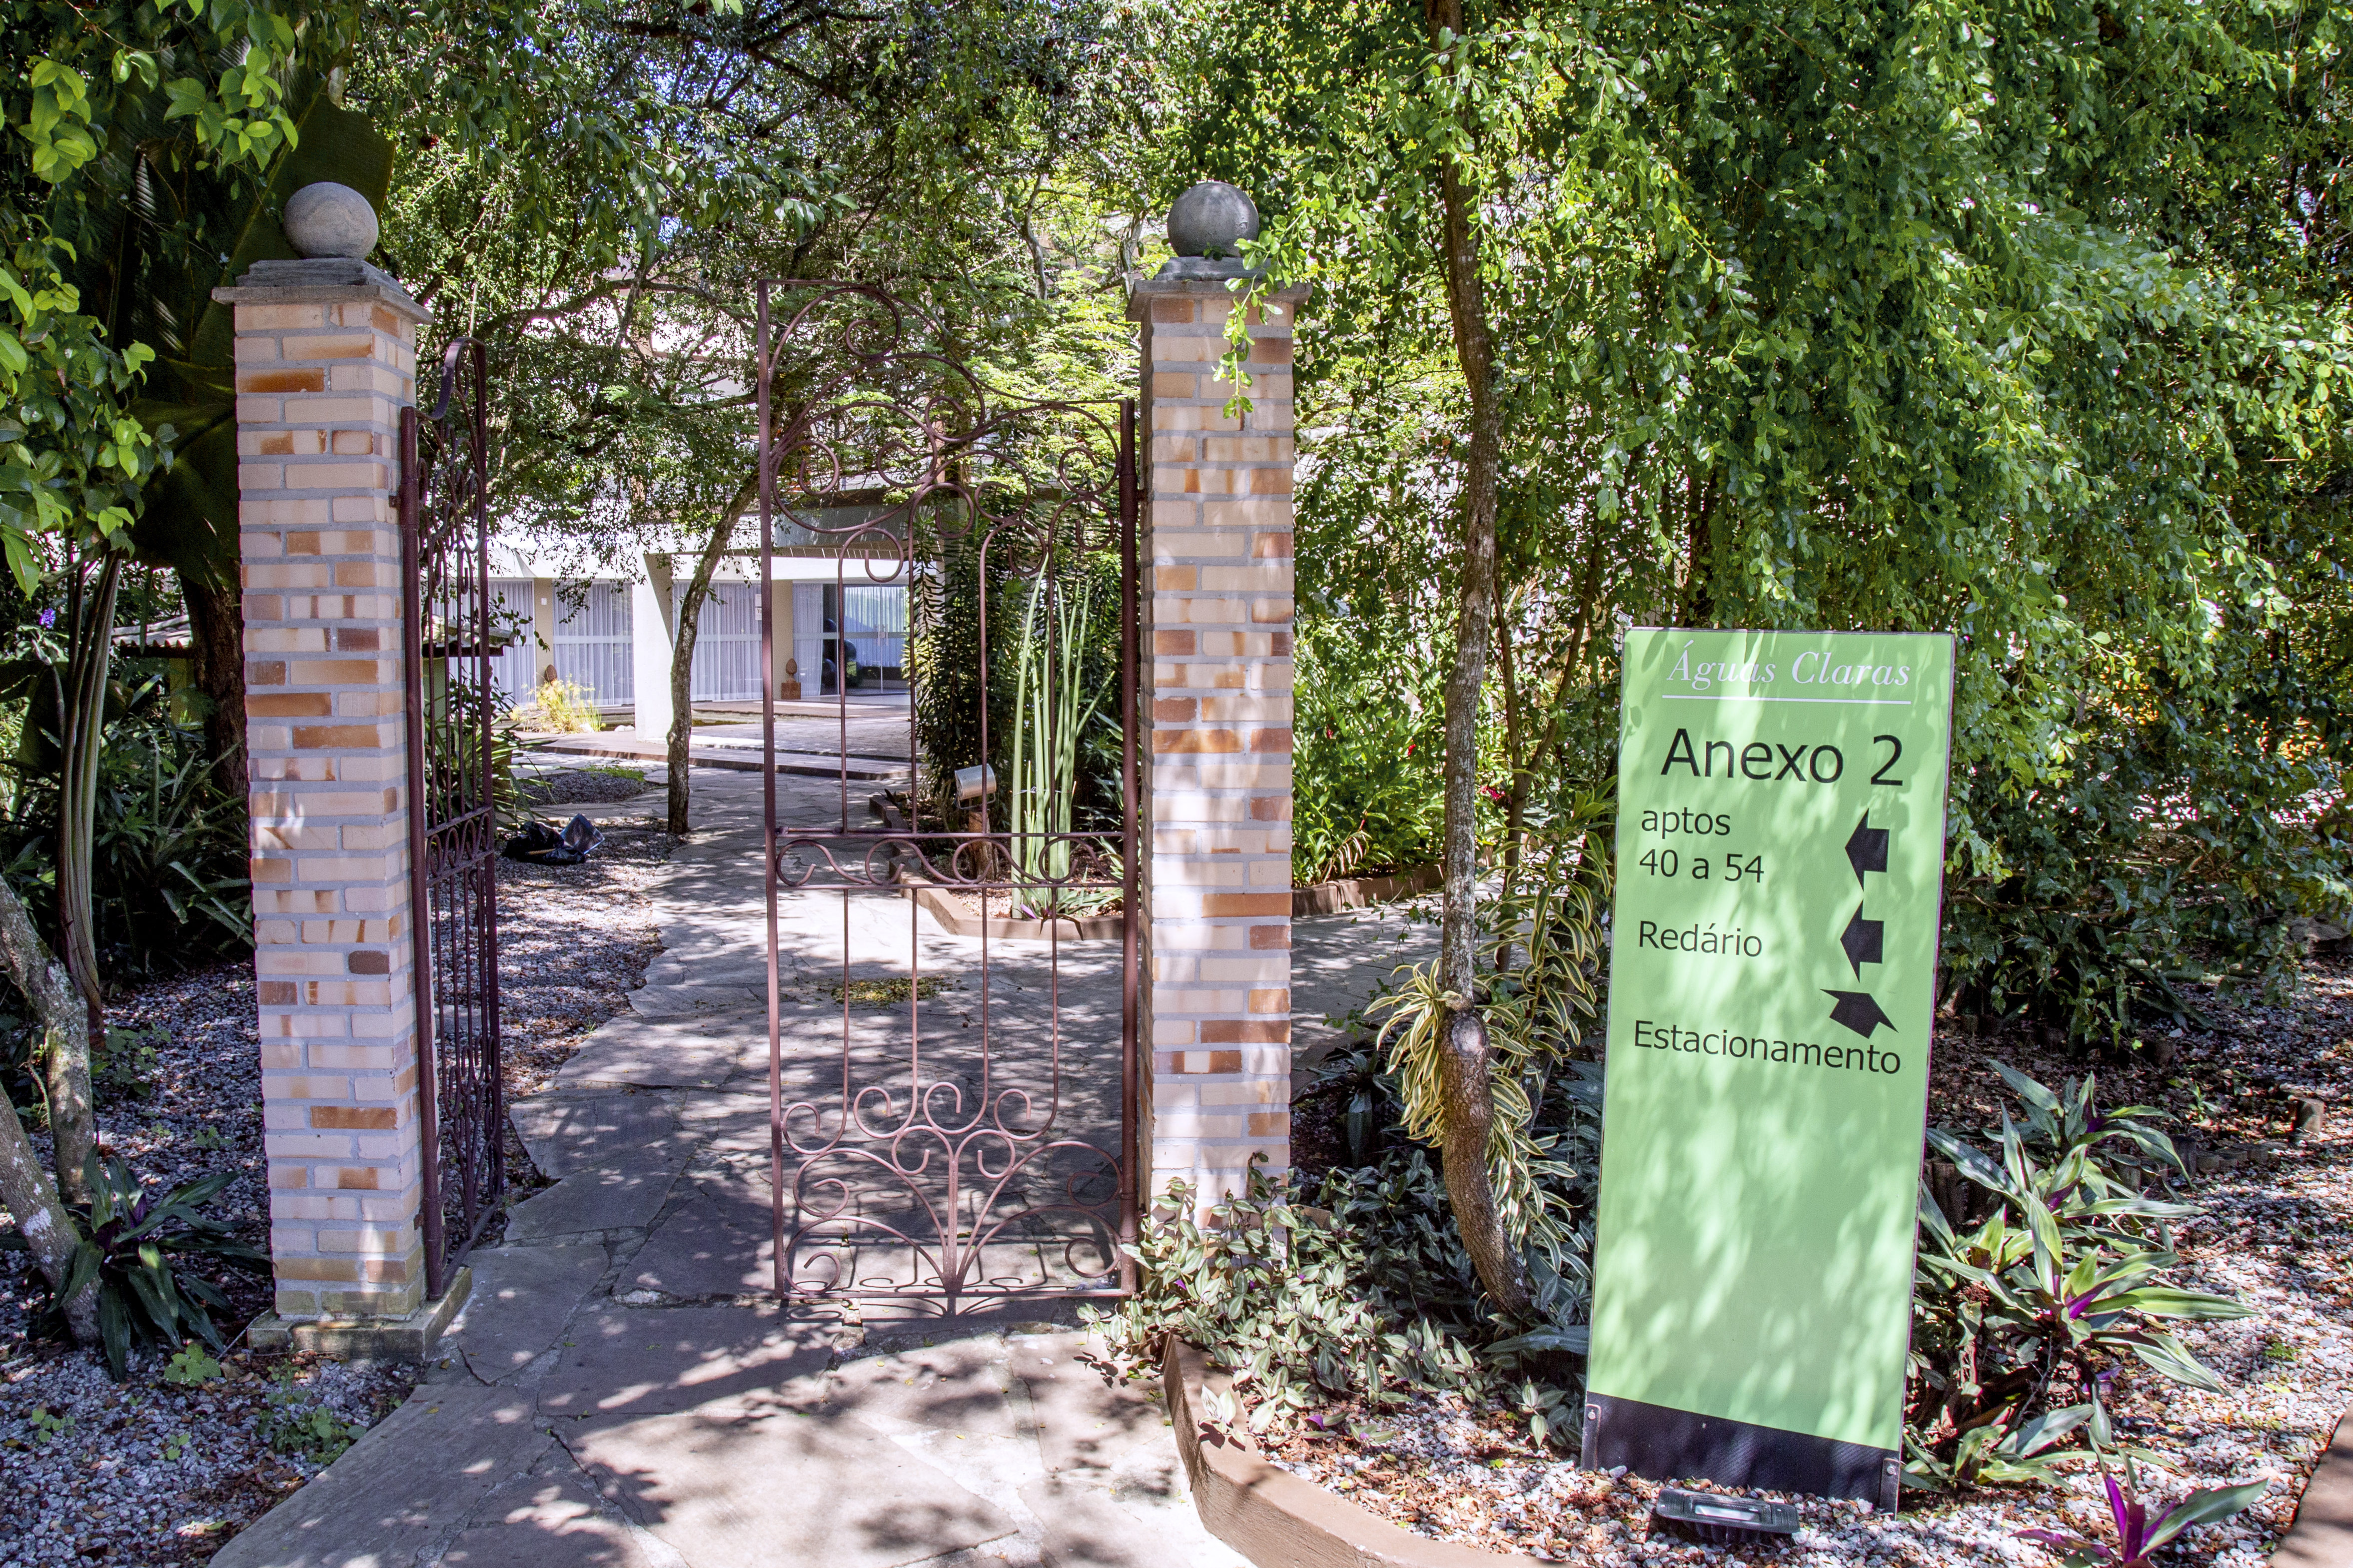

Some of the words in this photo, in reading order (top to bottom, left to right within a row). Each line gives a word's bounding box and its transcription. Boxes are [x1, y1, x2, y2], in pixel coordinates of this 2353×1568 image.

[1666, 639, 1776, 691] Águas
[1791, 651, 1910, 686] Claras
[1660, 728, 1844, 784] Anexo
[1870, 734, 1904, 786] 2
[1641, 806, 1731, 839] aptos
[1639, 848, 1679, 877] 40
[1691, 857, 1709, 879] a
[1724, 852, 1765, 883] 54
[1639, 920, 1762, 957] Redário
[1634, 1019, 1901, 1074] Estacionamento
